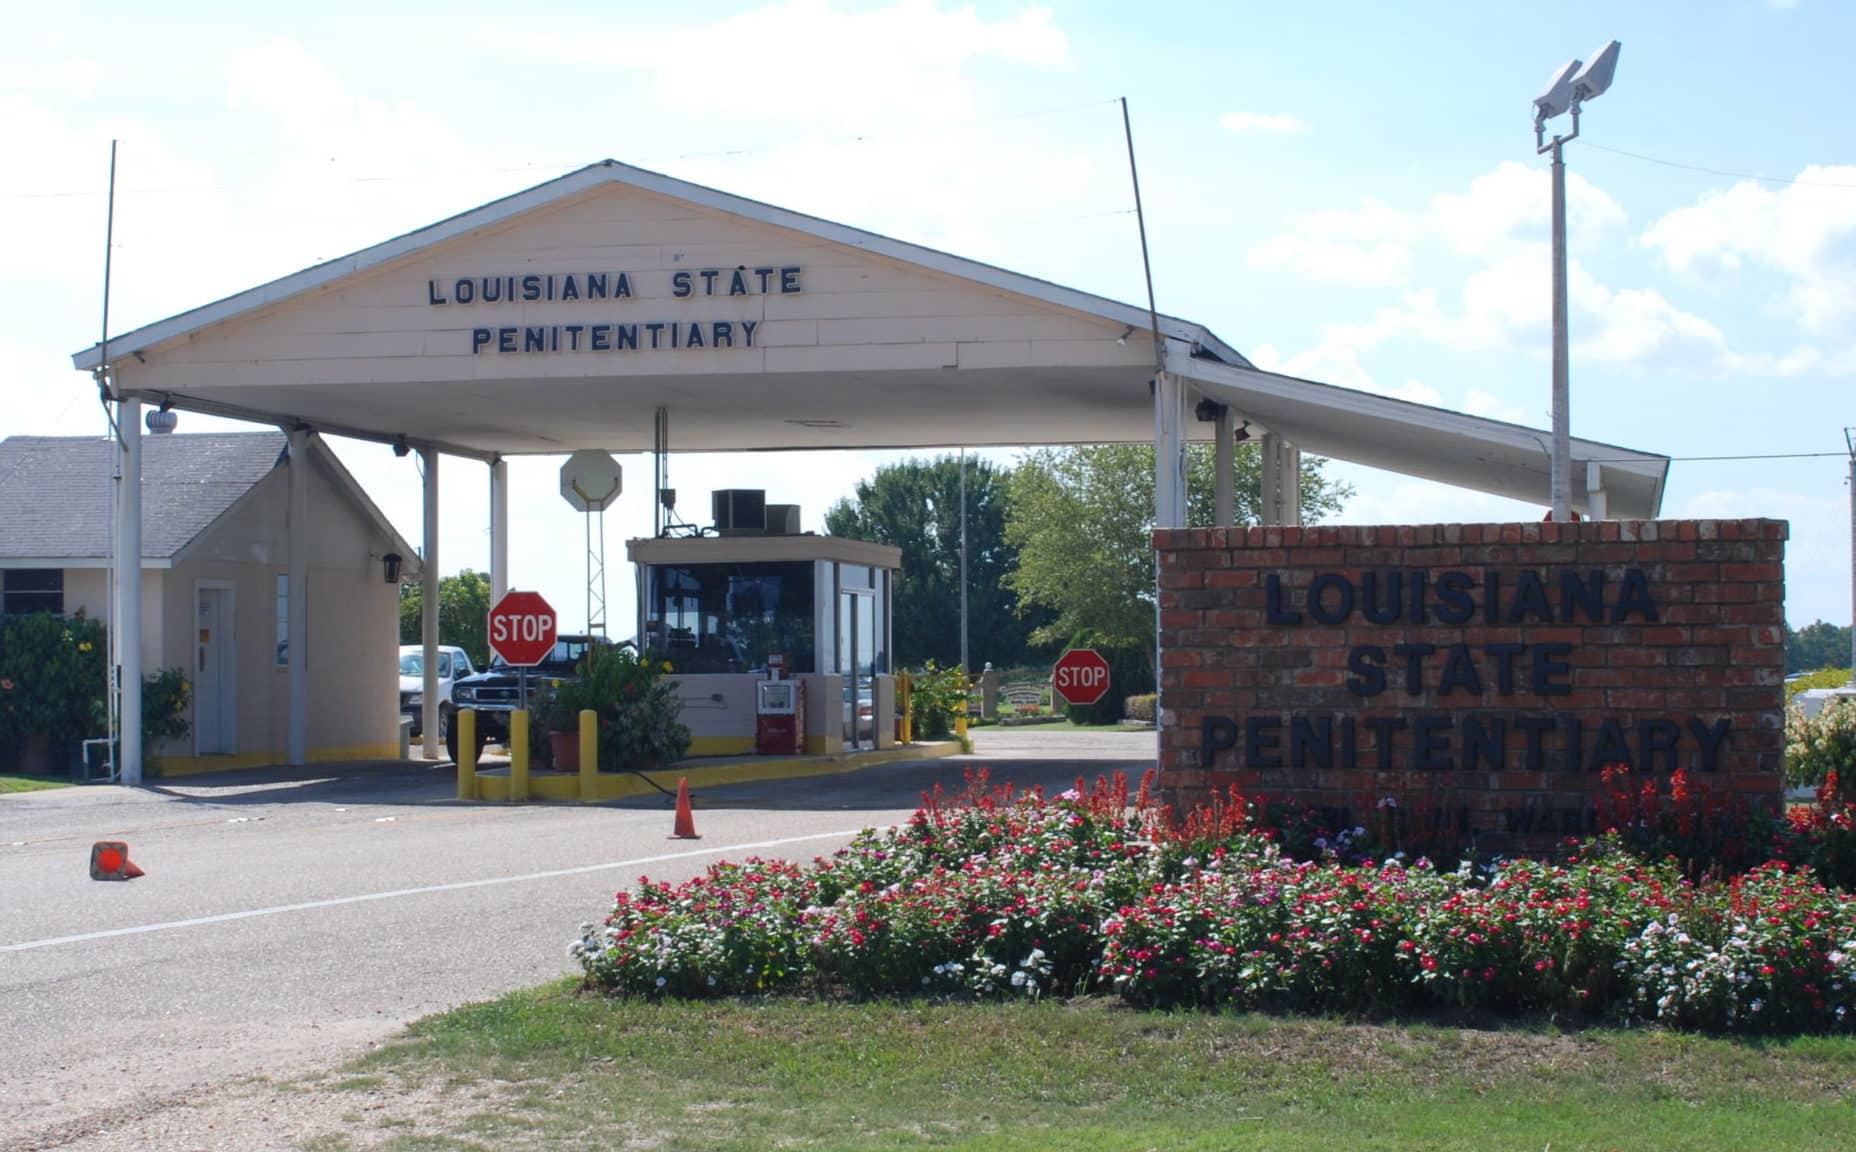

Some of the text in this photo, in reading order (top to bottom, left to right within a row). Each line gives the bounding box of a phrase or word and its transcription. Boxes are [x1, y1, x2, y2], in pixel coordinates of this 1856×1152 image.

[429, 267, 802, 305] LOUISIANA STATE
[472, 321, 758, 354] PENITENTIARY
[1266, 568, 1660, 626] LOUISIANA
[493, 614, 553, 642] STOP
[1059, 667, 1105, 687] STOP
[1347, 643, 1573, 697] STATE
[1201, 716, 1732, 770] PENITENTIARY
